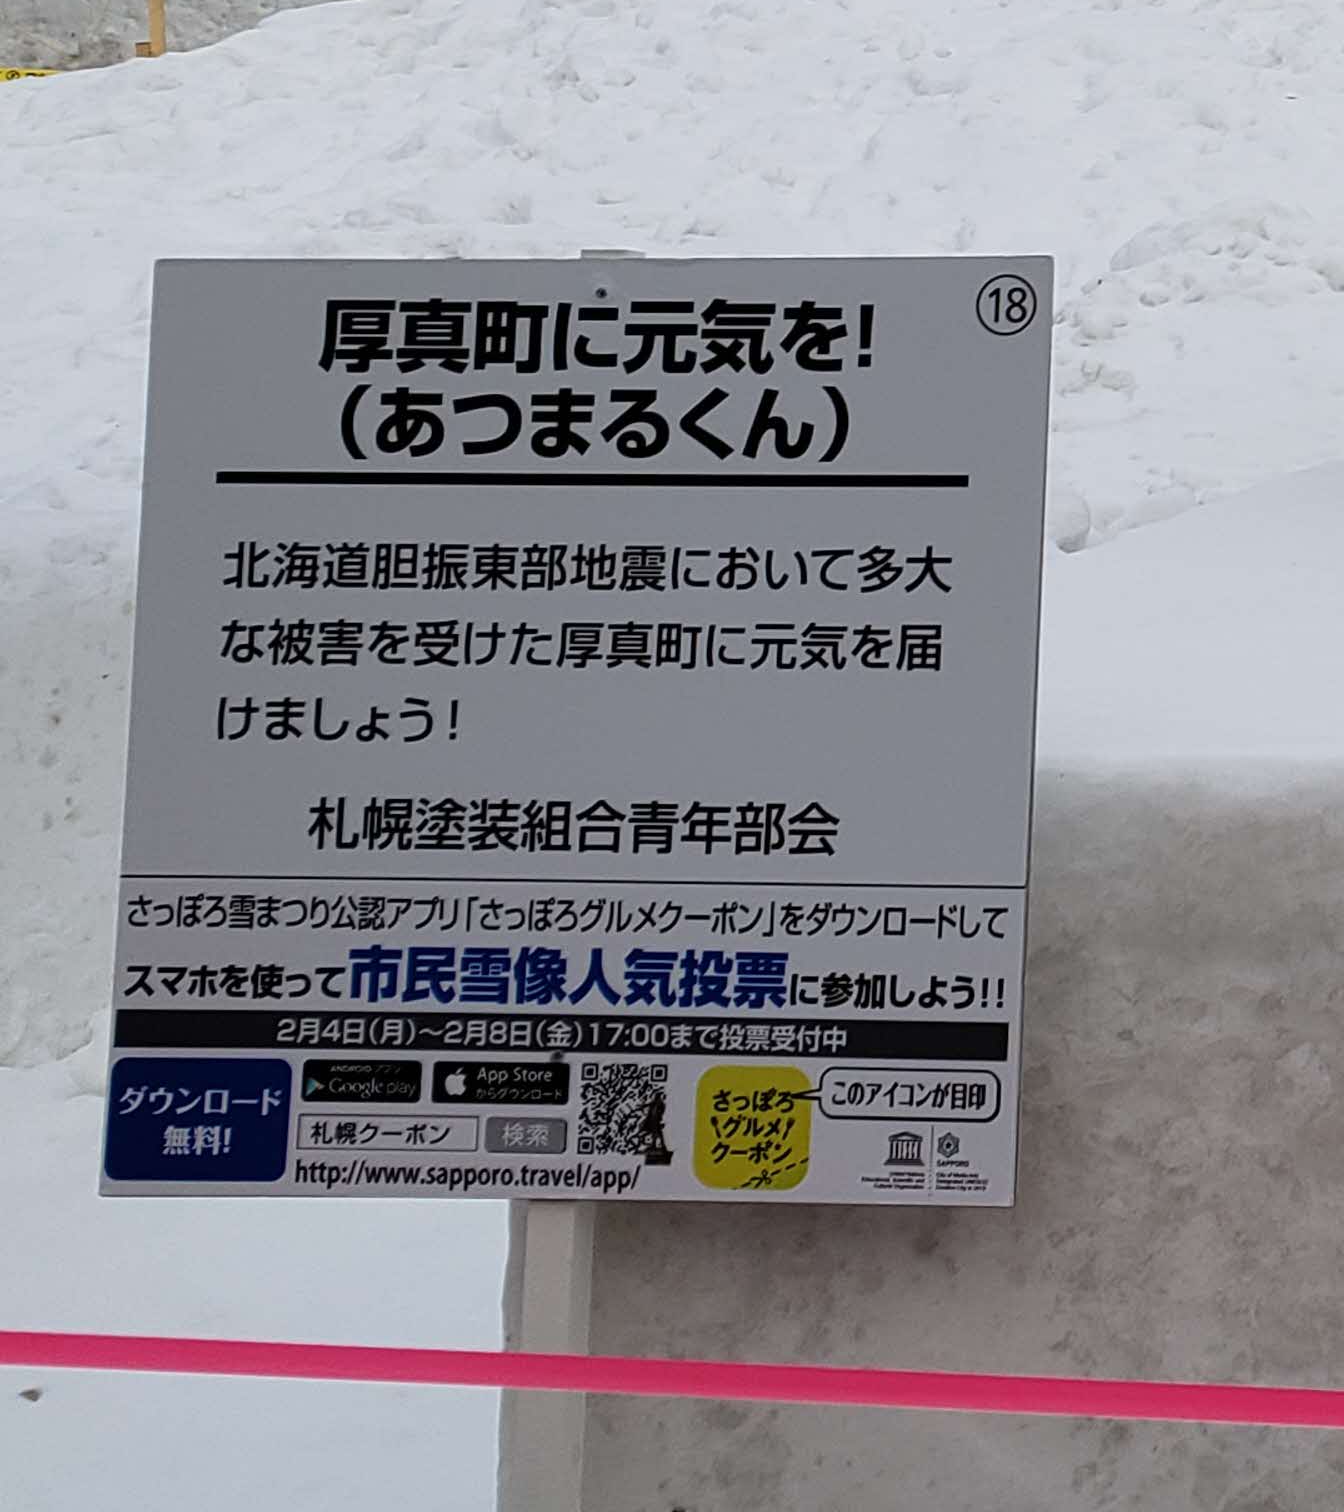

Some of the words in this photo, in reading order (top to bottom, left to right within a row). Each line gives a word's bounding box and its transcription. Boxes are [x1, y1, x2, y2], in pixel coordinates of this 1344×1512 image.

[317, 297, 876, 376] 厚真町に元気を!
[339, 383, 852, 464] (あつまるくん)
[223, 541, 952, 593] 北海道胆振東部地震において多大
[219, 618, 943, 672] な被害を受けた厚真町に元気を届
[216, 695, 460, 743] けましょう!
[307, 796, 840, 856] 札幌塗装組合青年部会
[329, 1077, 384, 1098] Google
[386, 1080, 416, 1098] play
[477, 1067, 508, 1084] App
[513, 1067, 553, 1082] Store
[119, 1085, 283, 1116] ダウンロード
[711, 1087, 795, 1113] さっぽろ
[830, 1080, 986, 1111] このアイコンが目印
[162, 1125, 232, 1156] 無料!
[310, 1120, 451, 1146] 札幌クーポン
[500, 1122, 550, 1148] 検索
[722, 1116, 782, 1139] グルメ
[710, 1139, 793, 1165] クーポン
[294, 1159, 642, 1194] http://www.sapporo.travel/app/
